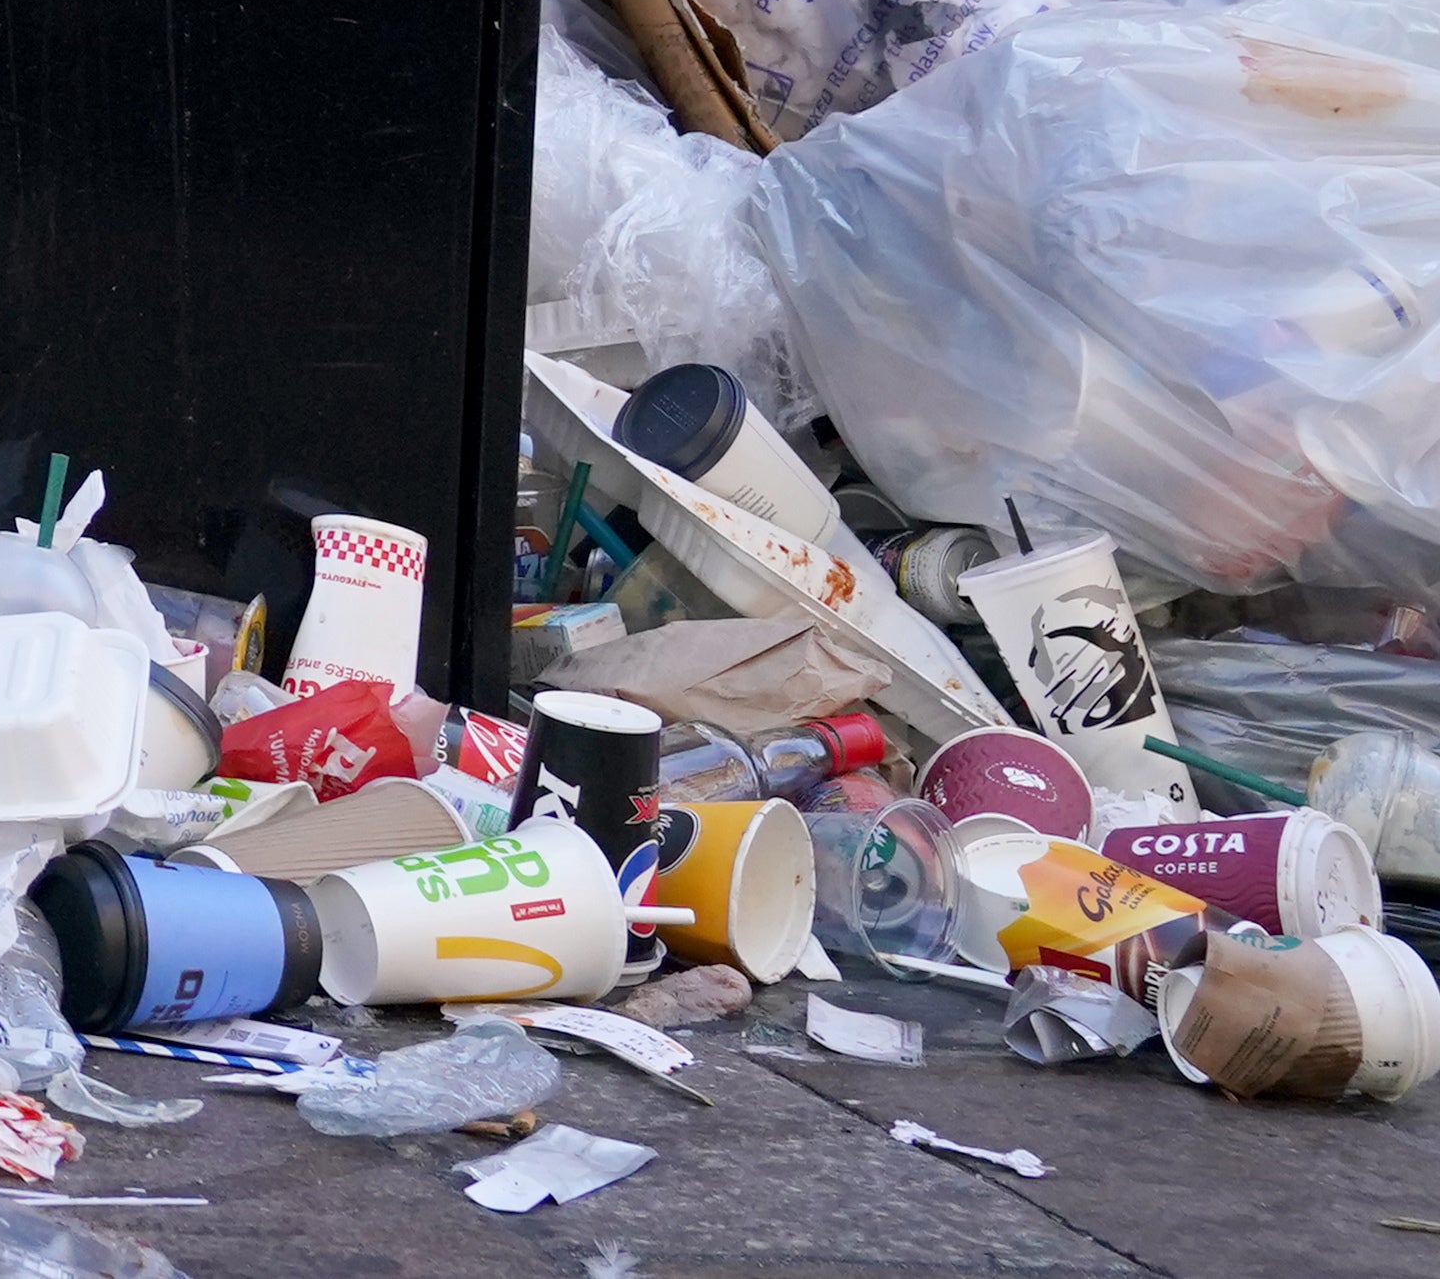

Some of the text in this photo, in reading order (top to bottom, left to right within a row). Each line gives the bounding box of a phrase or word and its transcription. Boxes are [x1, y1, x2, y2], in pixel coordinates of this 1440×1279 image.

[436, 844, 512, 895] n
[489, 837, 550, 889] cD
[1131, 832, 1245, 858] COSTA
[1153, 861, 1218, 875] COFFEE
[393, 856, 451, 903] d's
[1076, 857, 1128, 924] Galaxy
[298, 901, 312, 955] MOCHA
